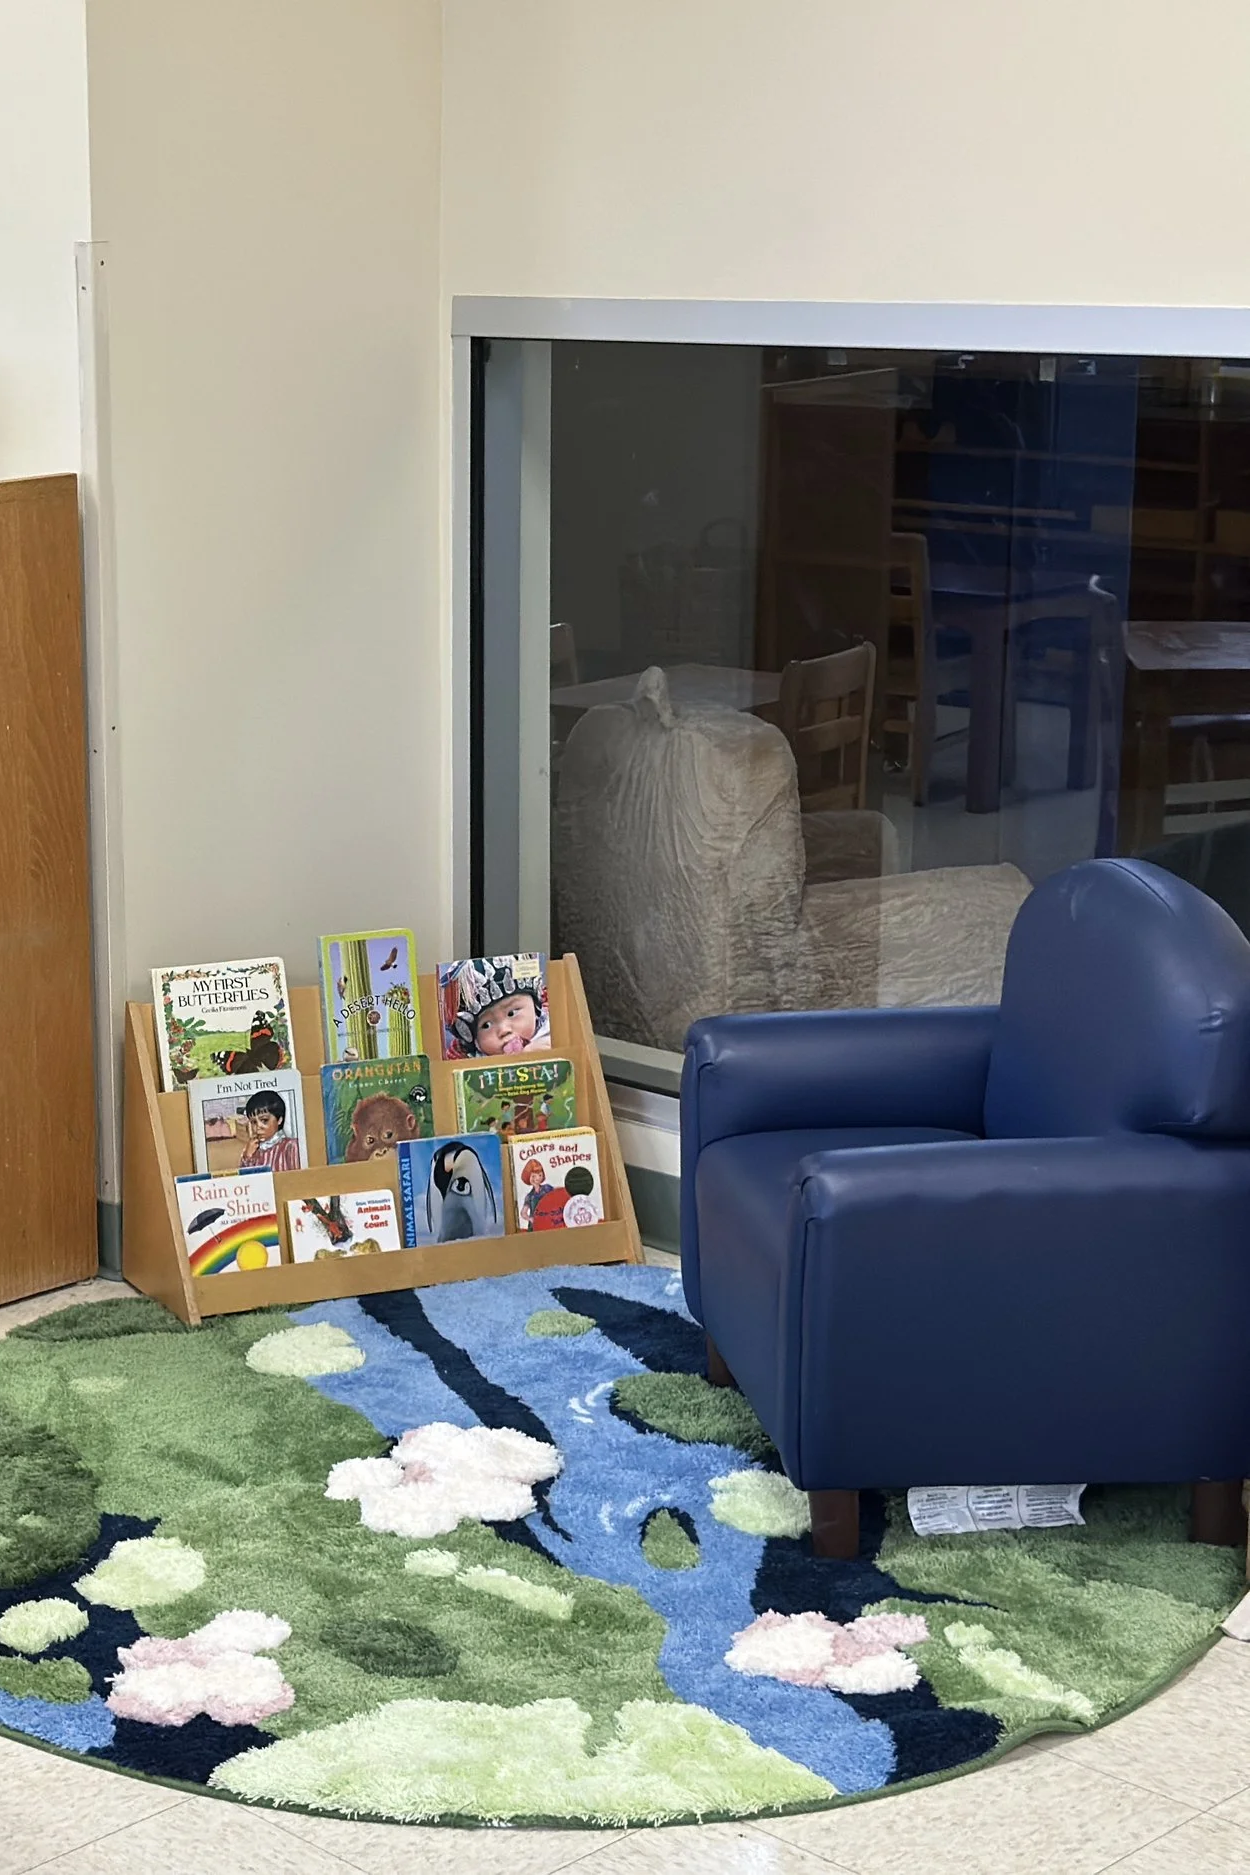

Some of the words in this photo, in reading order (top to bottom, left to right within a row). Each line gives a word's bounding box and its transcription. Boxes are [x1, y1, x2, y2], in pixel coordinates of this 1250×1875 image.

[192, 980, 212, 994] MY
[214, 976, 252, 991] FIRST
[178, 988, 269, 1008] BUTTERFLIES
[332, 1018, 343, 1028] A
[340, 995, 381, 1019] DESERT
[384, 997, 416, 1020] HELLO
[332, 1058, 422, 1081] ORANGUTAN
[216, 1083, 232, 1094] I'm
[234, 1081, 252, 1092] Not
[254, 1077, 278, 1089] Tired
[518, 1143, 555, 1161] Colors
[558, 1143, 578, 1152] and
[549, 1153, 592, 1168] Shapes
[401, 1158, 412, 1202] SAFARI
[192, 1182, 228, 1202] Rain
[233, 1184, 250, 1196] or
[226, 1199, 270, 1217] Shine
[357, 1204, 392, 1214] Animals
[364, 1220, 388, 1229] Count
[404, 1204, 416, 1248] NIMAL
